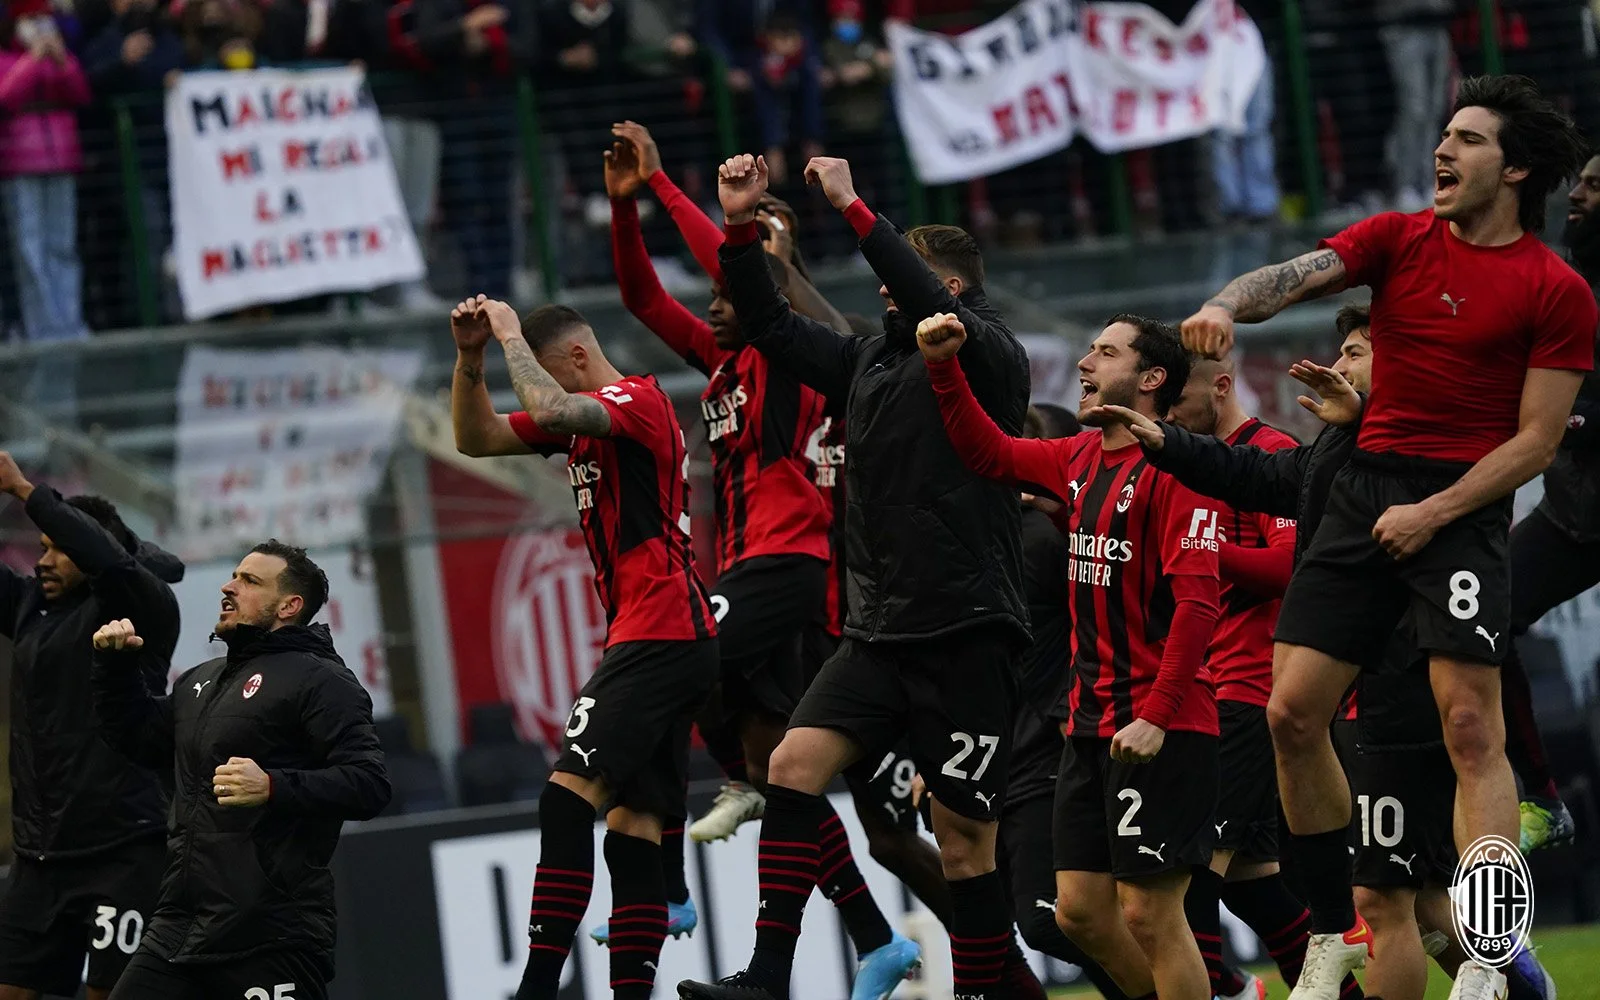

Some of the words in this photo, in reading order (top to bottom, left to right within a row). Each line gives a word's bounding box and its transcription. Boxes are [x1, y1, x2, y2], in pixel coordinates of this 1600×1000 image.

[254, 185, 306, 224] LA
[1181, 537, 1219, 553] BitME
[1078, 560, 1112, 587] BETTER
[1448, 570, 1481, 621] 8
[565, 696, 596, 738] 3
[941, 731, 1000, 781] 27
[1117, 788, 1142, 836] 2
[1357, 794, 1404, 847] 10
[91, 904, 144, 955] 30
